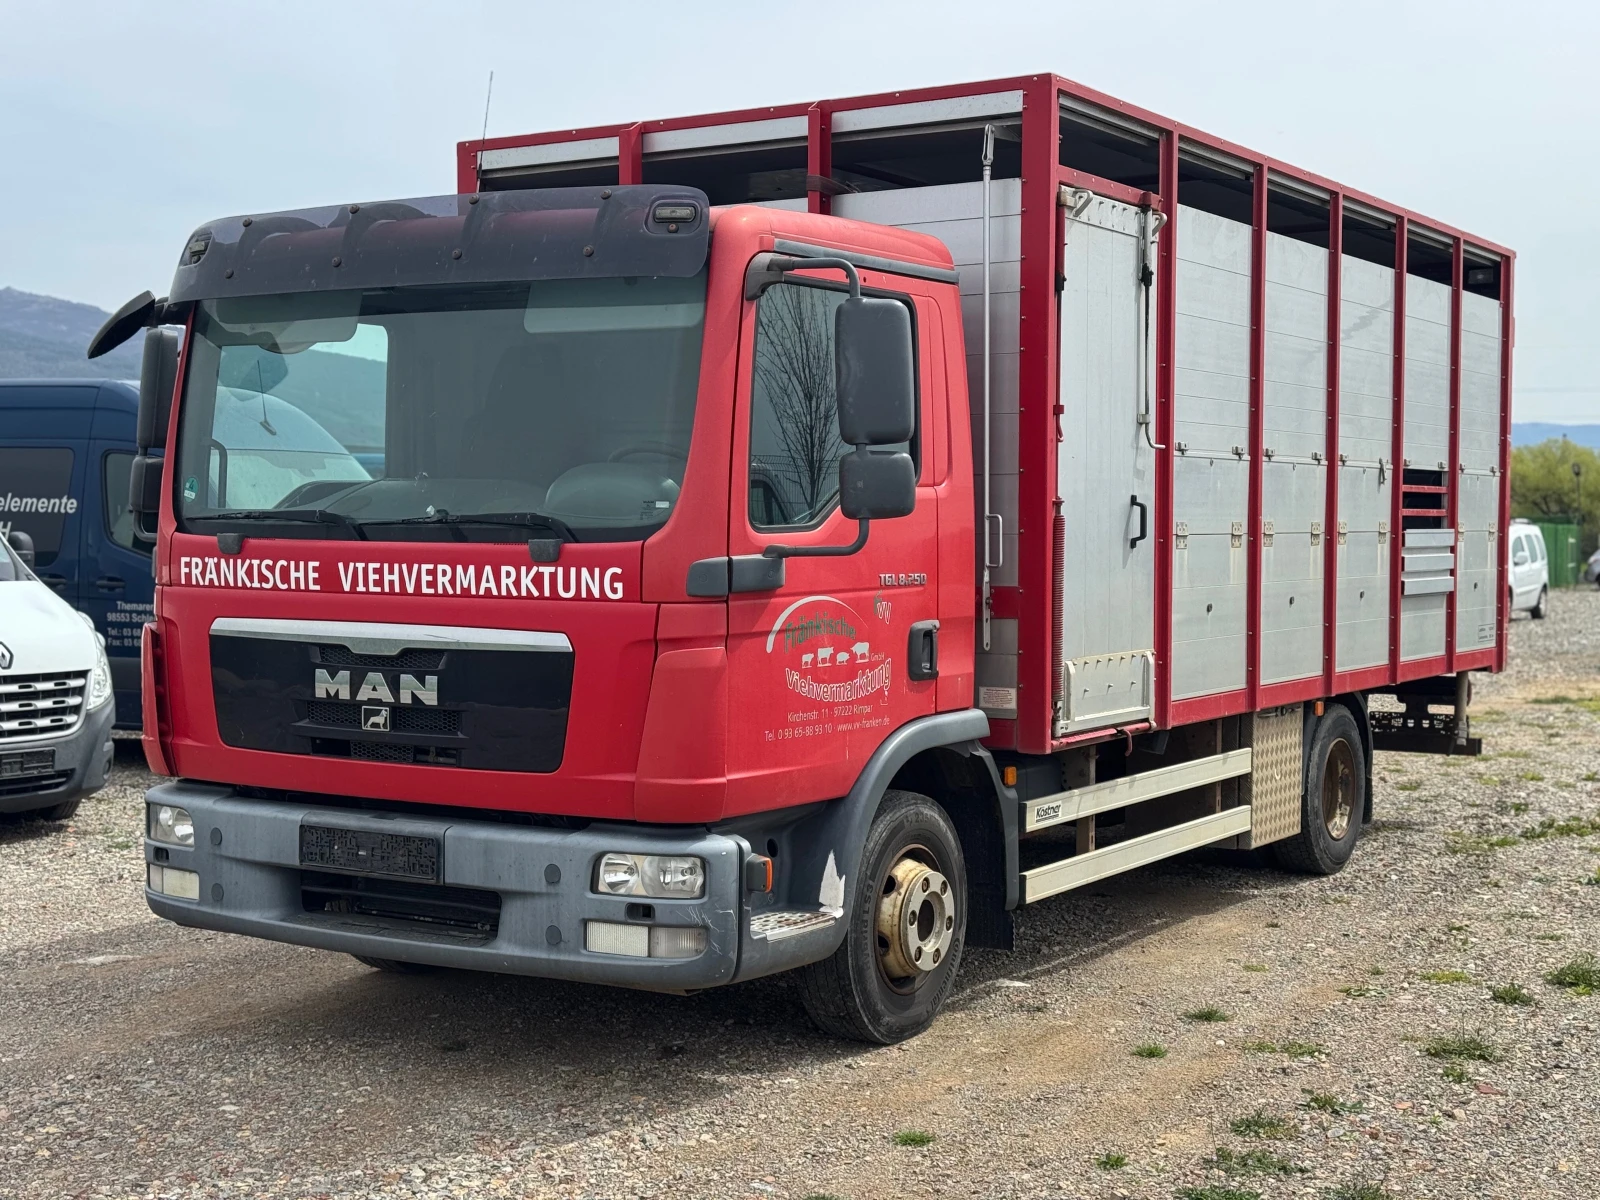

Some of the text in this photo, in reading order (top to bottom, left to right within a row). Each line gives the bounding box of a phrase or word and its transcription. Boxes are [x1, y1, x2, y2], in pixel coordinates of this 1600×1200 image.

[0, 492, 78, 514] elemente
[179, 556, 624, 600] FRÄNKISCHE VIEHVERMARKTUNG
[879, 572, 927, 587] TGL 8.250
[106, 612, 130, 622] 98553
[785, 611, 856, 653] Fränkische
[871, 652, 885, 662] GmbH
[314, 668, 439, 706] MAN
[785, 657, 892, 702] Viehvermarktung
[787, 703, 874, 723] Kirchenstr. 11 97222 Rimpar
[764, 731, 776, 742] Tel.
[825, 723, 833, 734] 10
[837, 717, 890, 732] www.vv-franken.de
